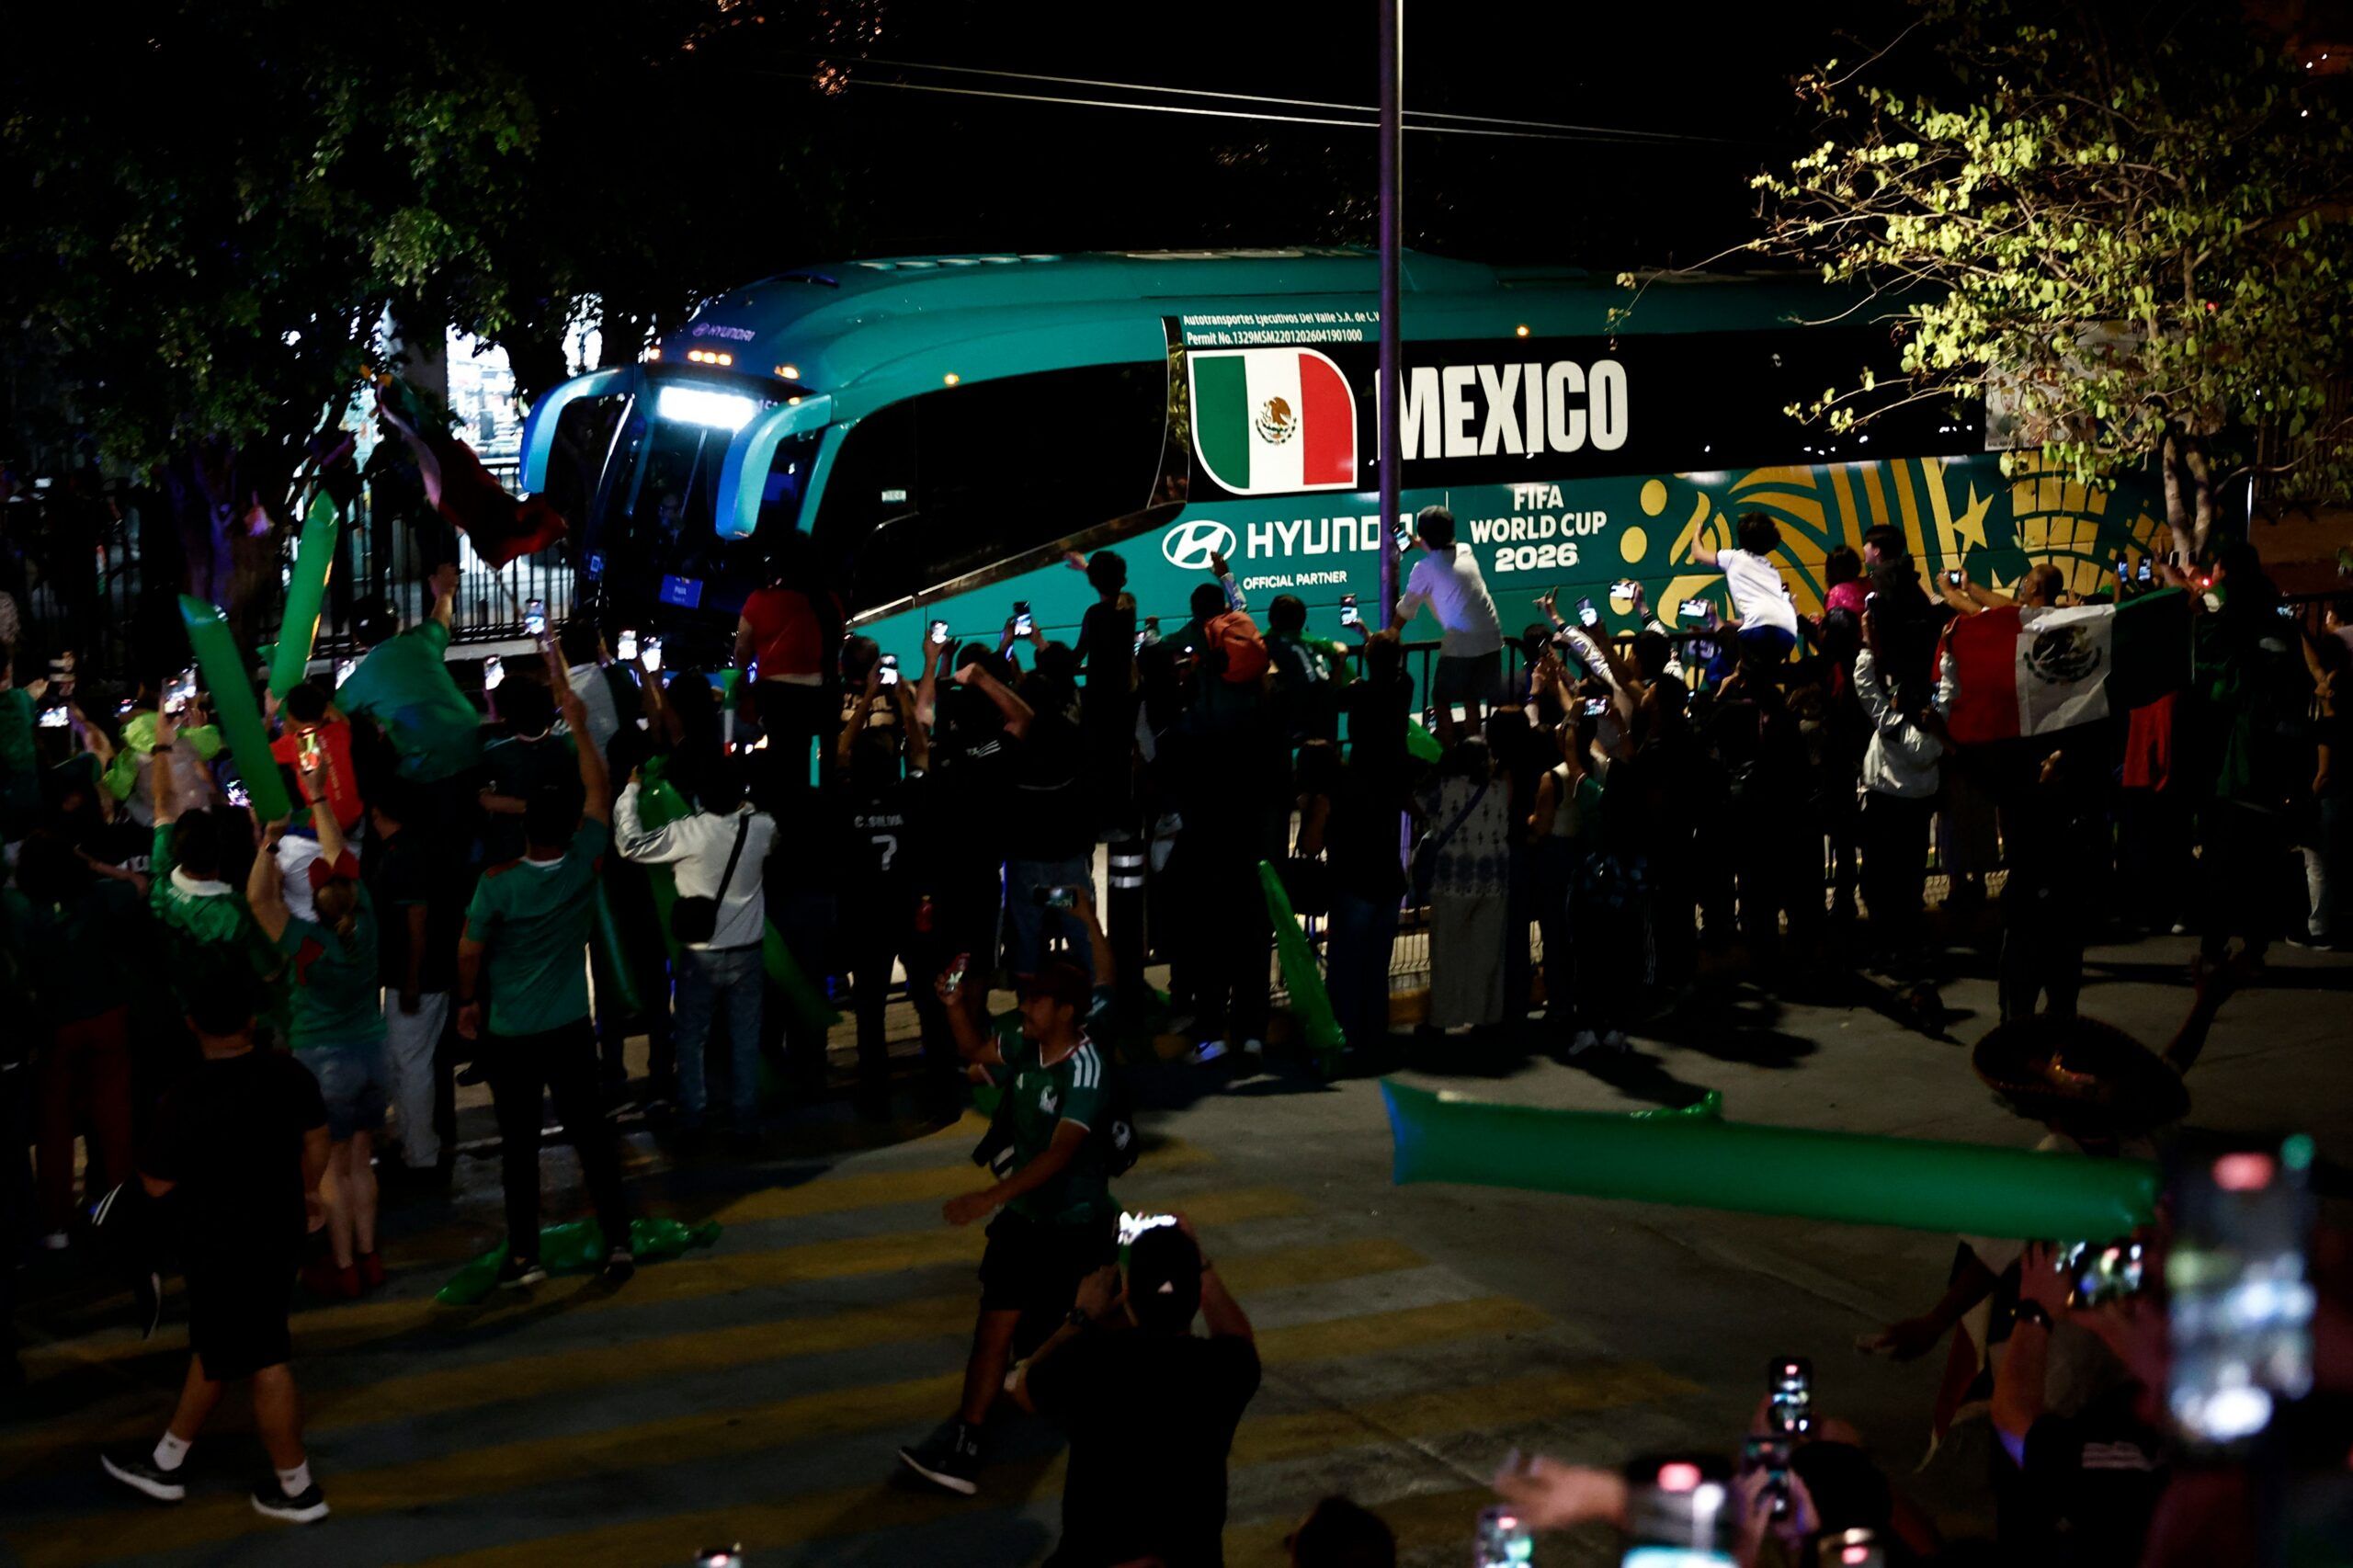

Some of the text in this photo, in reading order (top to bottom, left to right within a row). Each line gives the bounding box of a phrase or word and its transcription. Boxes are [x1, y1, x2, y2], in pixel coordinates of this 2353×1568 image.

[708, 325, 756, 343] HYUNDAI
[1183, 314, 1254, 328] Autotransportes
[1314, 312, 1336, 324] Valle
[1355, 311, 1366, 323] de
[1187, 332, 1217, 346] Permit
[1375, 359, 1628, 460] MEXICO
[1514, 484, 1564, 511] FIFA
[1246, 512, 1420, 559] HYUND
[1470, 511, 1608, 544] WORLD CUP
[1495, 542, 1578, 573] 2026
[1243, 571, 1347, 590] OFFICIAL PARTNER
[871, 834, 897, 871] 7
